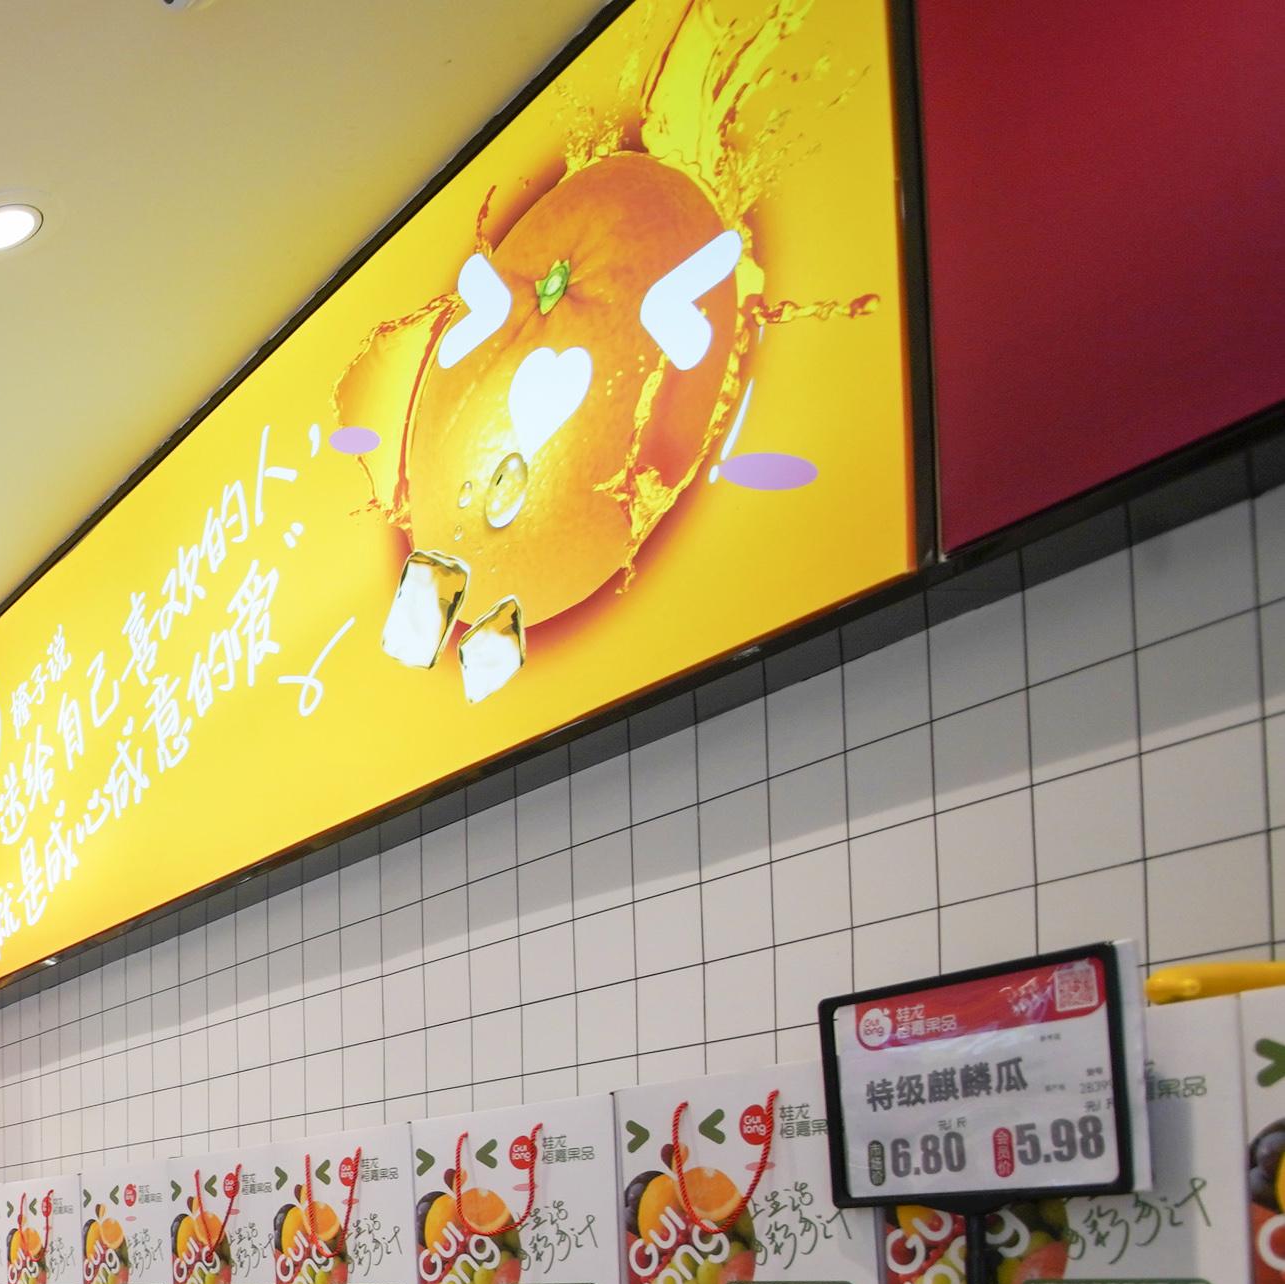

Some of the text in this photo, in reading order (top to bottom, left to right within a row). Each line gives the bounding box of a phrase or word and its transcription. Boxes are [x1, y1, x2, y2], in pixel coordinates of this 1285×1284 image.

[896, 1005, 925, 1021] 桂龙
[867, 1057, 1027, 1112] 特级麒麟瓜
[779, 1104, 810, 1121] 桂龙
[779, 1118, 828, 1139] 恒嘉果
[890, 1131, 966, 1178] 6.80
[995, 1130, 1013, 1176] 会员价
[1015, 1115, 1106, 1167] 5.98
[84, 1242, 104, 1281] Gui
[174, 1237, 199, 1283] Gui
[276, 1230, 308, 1282] Gui
[419, 1221, 465, 1283] Gui
[629, 1206, 685, 1277] Gui
[8, 1250, 26, 1284] Gui
